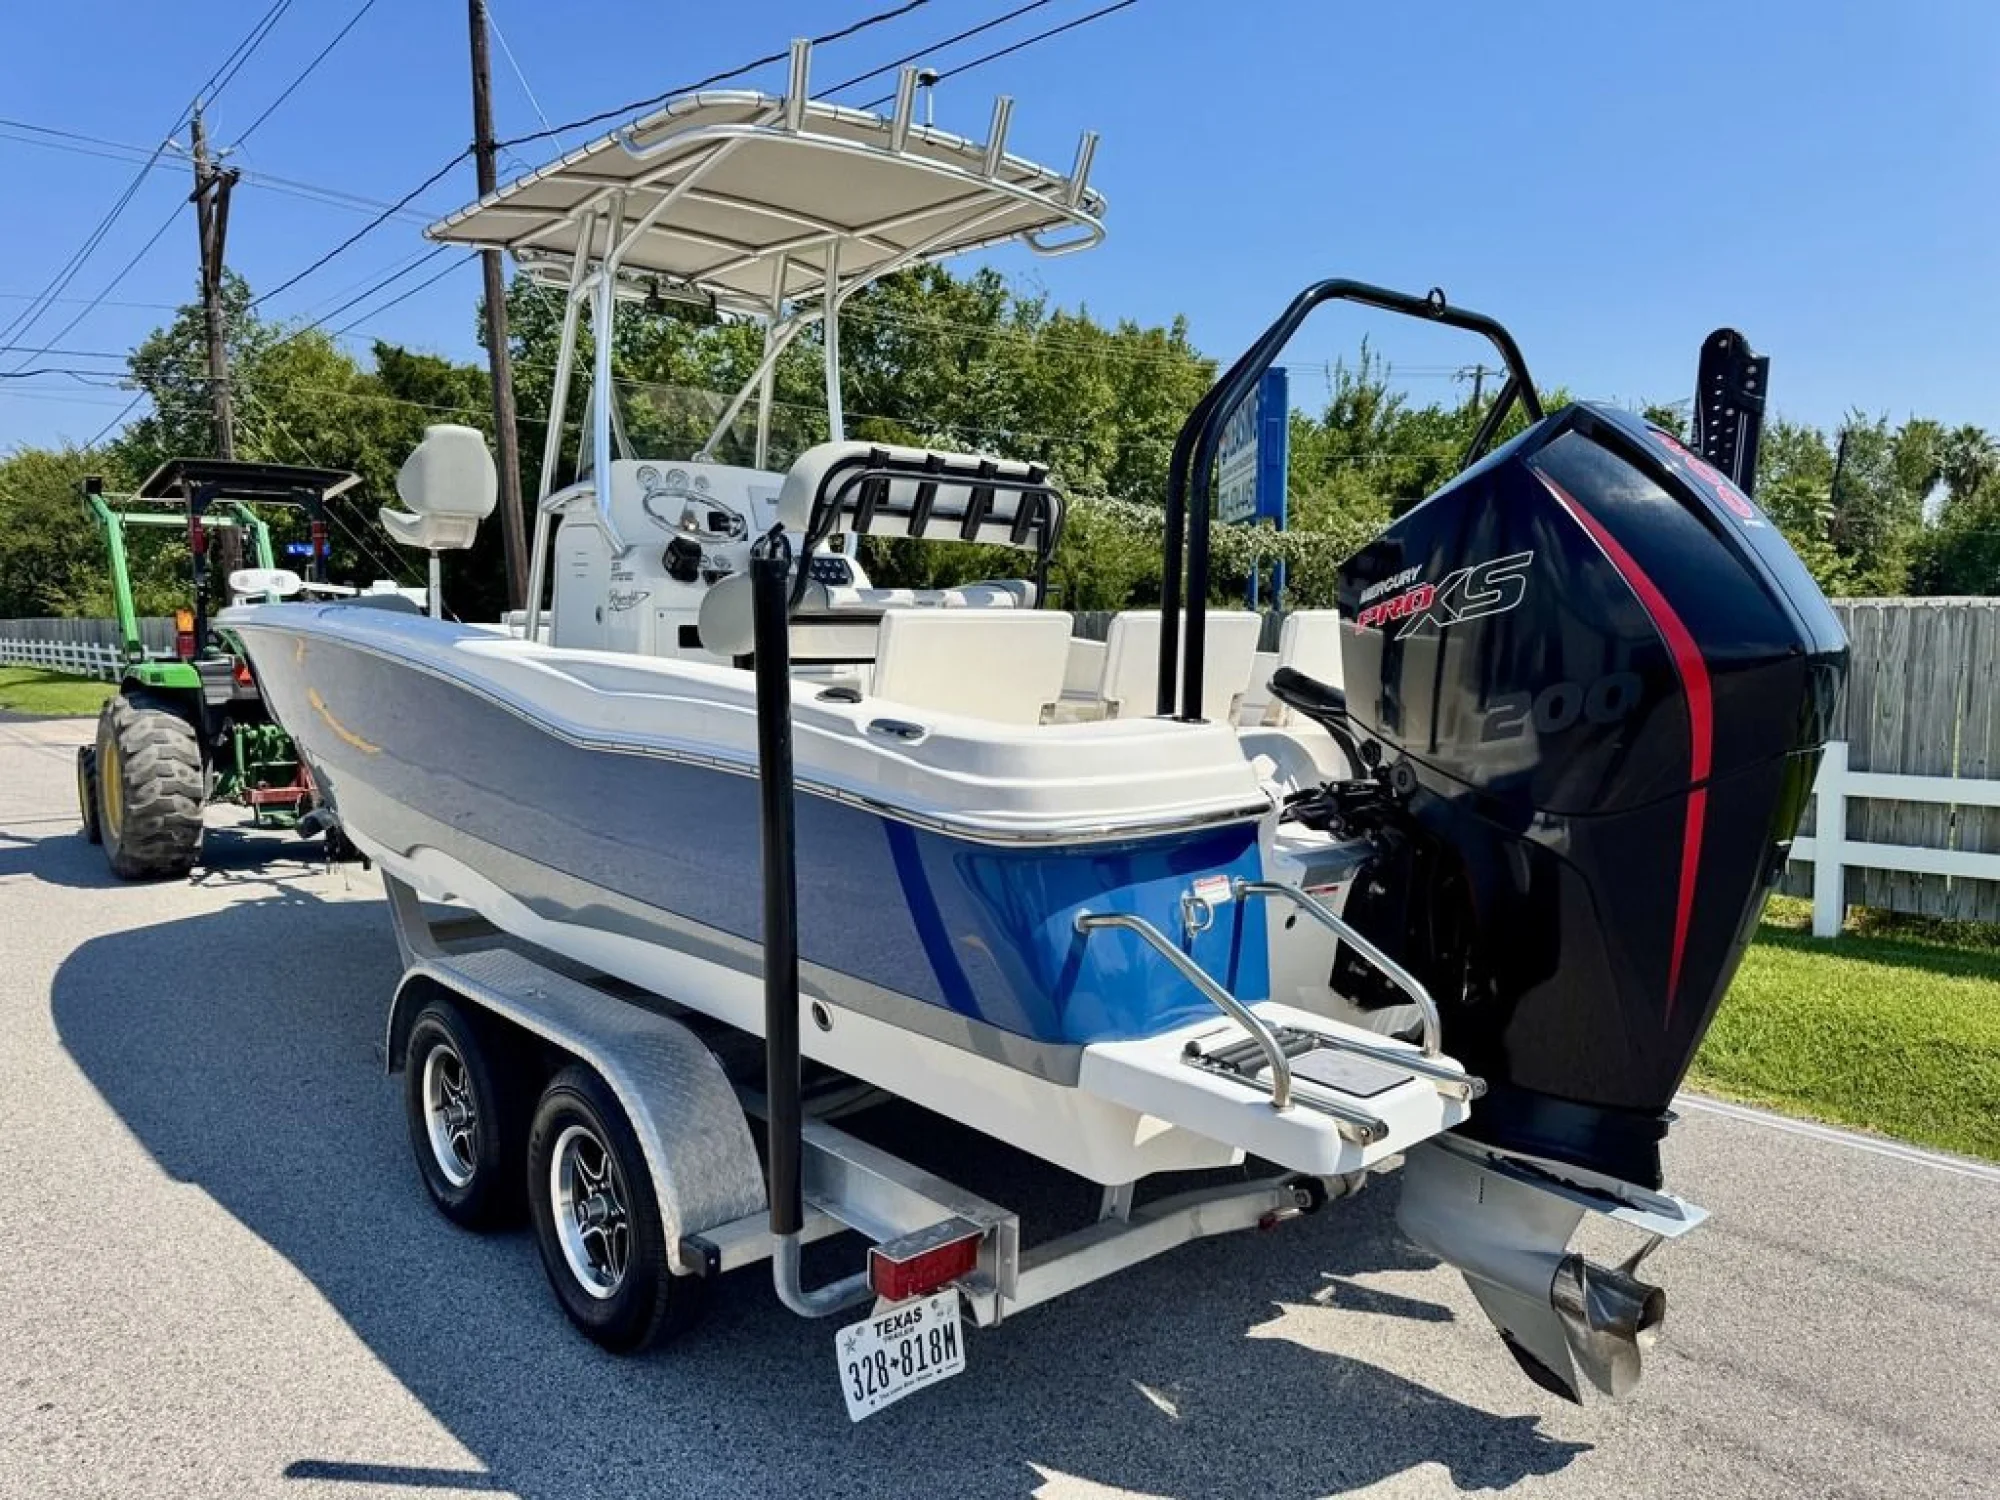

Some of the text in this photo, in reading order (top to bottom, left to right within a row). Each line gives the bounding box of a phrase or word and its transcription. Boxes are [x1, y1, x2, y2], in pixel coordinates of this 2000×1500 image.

[1359, 564, 1422, 604] MERCURY
[1482, 672, 1643, 742] 200
[873, 1306, 922, 1336] TEXAS
